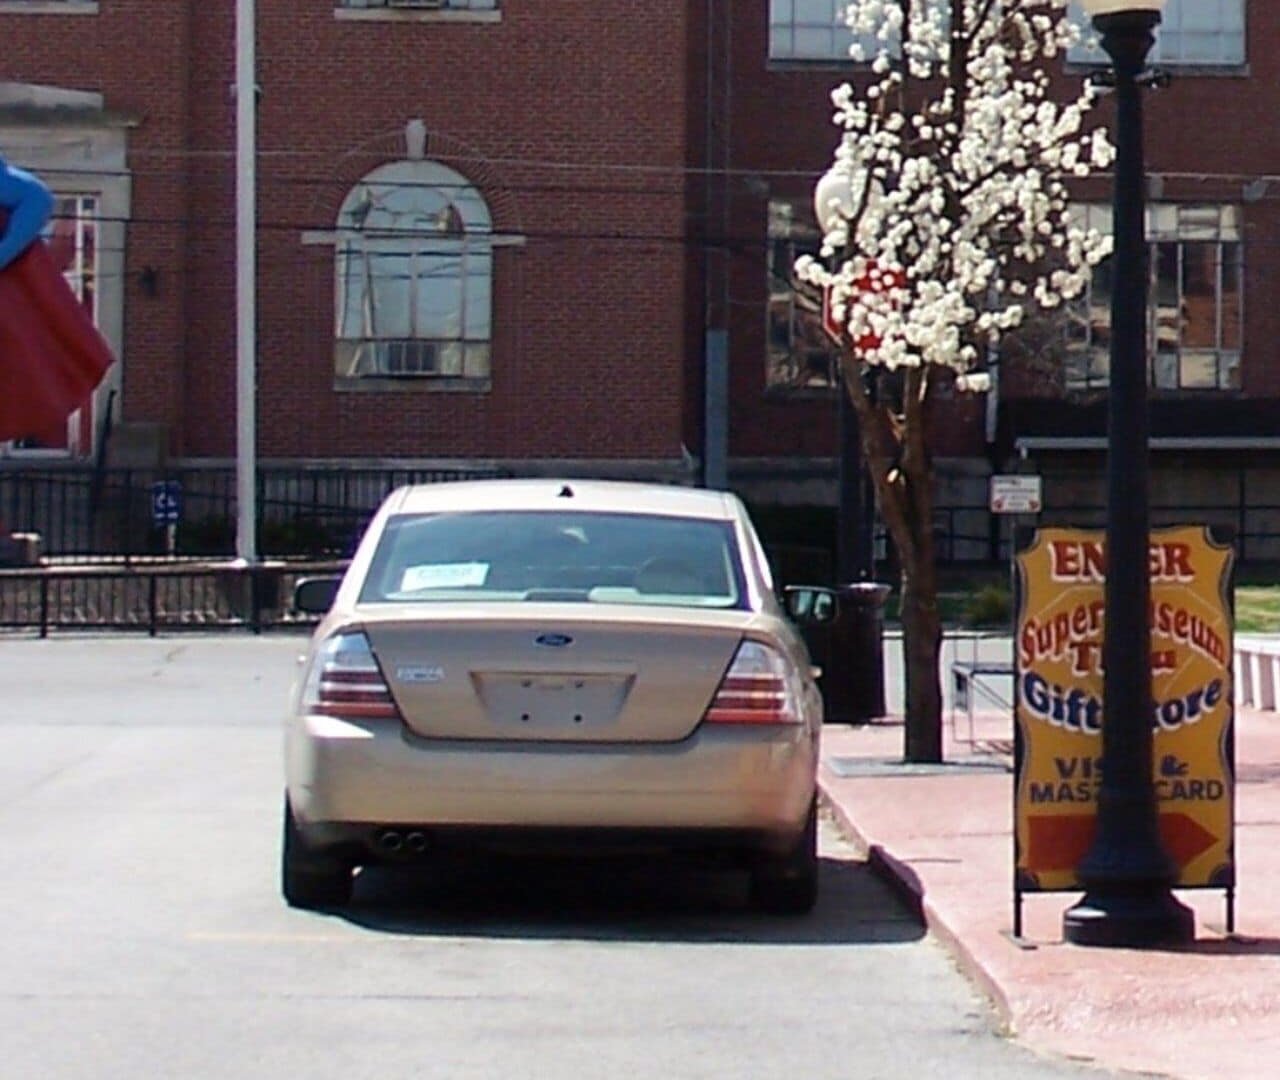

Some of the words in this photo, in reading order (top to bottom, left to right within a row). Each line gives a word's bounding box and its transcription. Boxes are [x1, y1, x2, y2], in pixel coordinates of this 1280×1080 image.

[1048, 540, 1196, 581] ENER
[1022, 671, 1104, 733] Gift
[1150, 678, 1223, 732] ore
